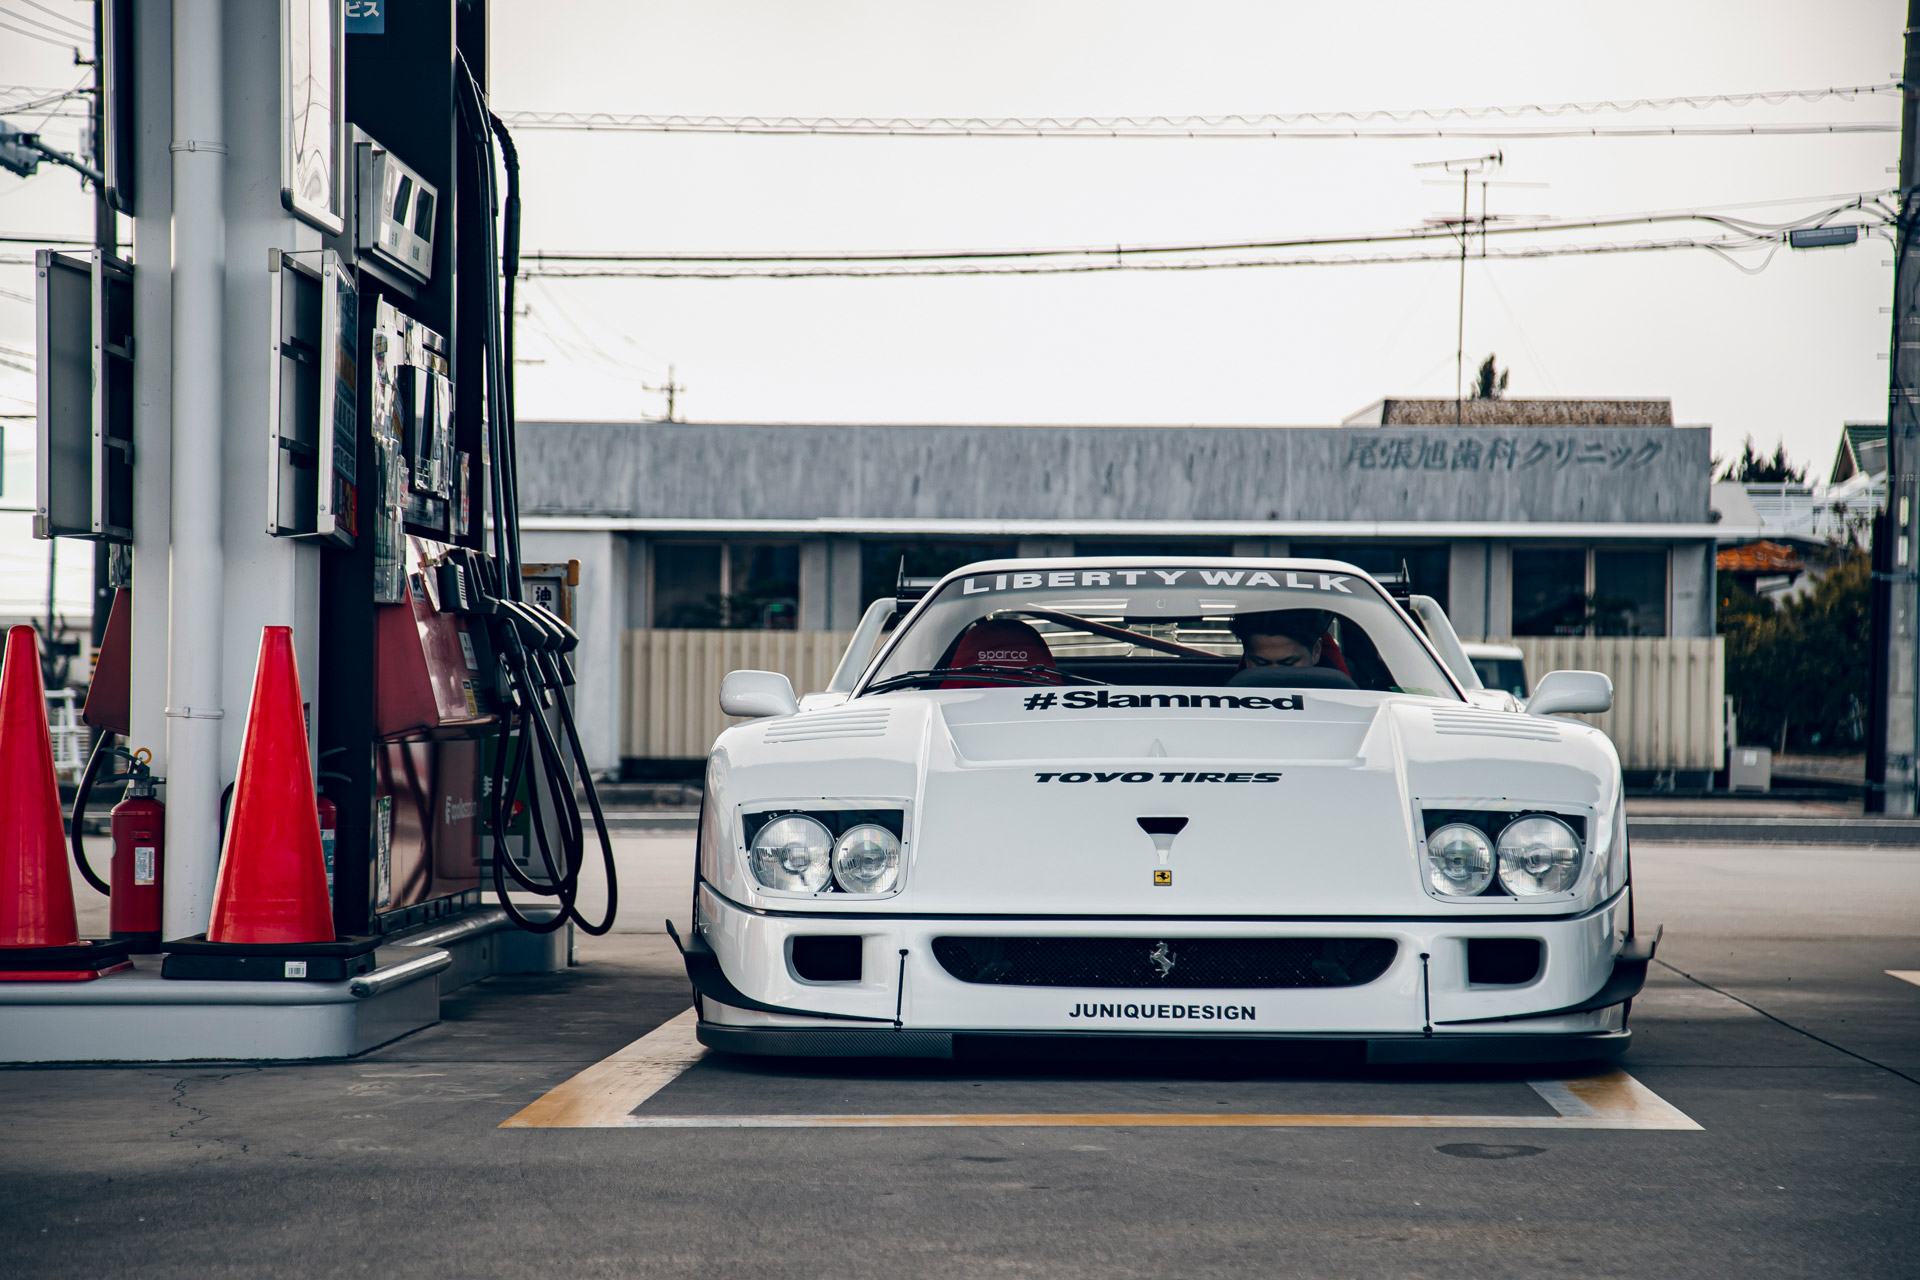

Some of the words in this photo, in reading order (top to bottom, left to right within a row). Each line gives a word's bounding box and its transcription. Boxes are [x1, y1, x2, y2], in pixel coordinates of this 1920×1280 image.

[1343, 436, 1664, 473] 尾張旭歯科クリニック
[963, 570, 1187, 595] LIBERTY
[1199, 570, 1353, 594] WALK
[978, 650, 1028, 661] sparco
[1023, 690, 1304, 711] #Slammed
[1034, 772, 1154, 783] TOYO
[1158, 772, 1283, 783] TIRES
[1069, 1003, 1256, 1021] JUNIQUEDESIGN
